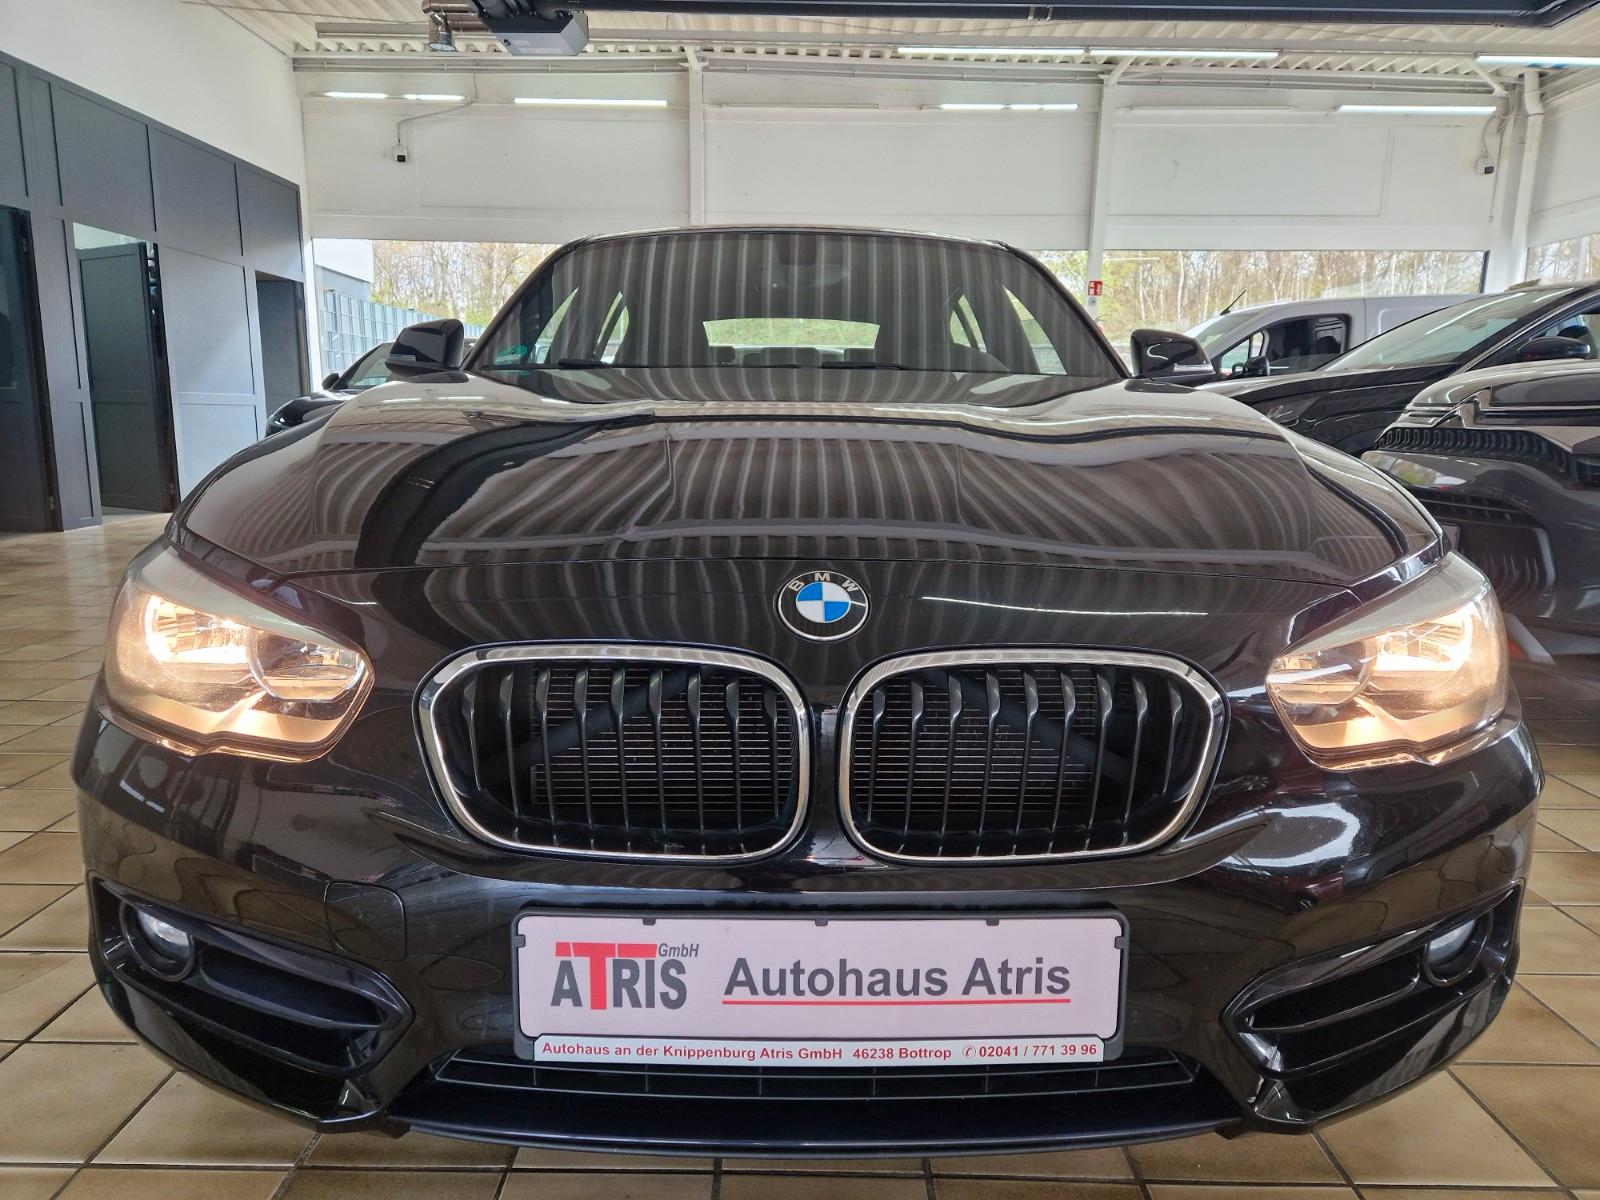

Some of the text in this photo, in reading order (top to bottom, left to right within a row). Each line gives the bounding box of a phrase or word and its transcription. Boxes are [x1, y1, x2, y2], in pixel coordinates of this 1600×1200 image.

[788, 572, 859, 592] BMW
[658, 943, 699, 958] GmbH
[551, 942, 687, 1010] ATRIS
[724, 957, 1071, 997] Autohaus Atris
[542, 1042, 610, 1056] Autohaus
[614, 1046, 632, 1056] an
[635, 1045, 658, 1057] der
[663, 1045, 756, 1061] Knippenburg
[760, 1046, 793, 1060] Atris
[798, 1047, 842, 1059] GmbH
[853, 1048, 894, 1060] 46238
[899, 1047, 952, 1061] Bottrop
[978, 1045, 1019, 1057] 02041
[1032, 1045, 1055, 1056] 771
[1060, 1044, 1077, 1056] 39
[1080, 1043, 1097, 1055] 96
